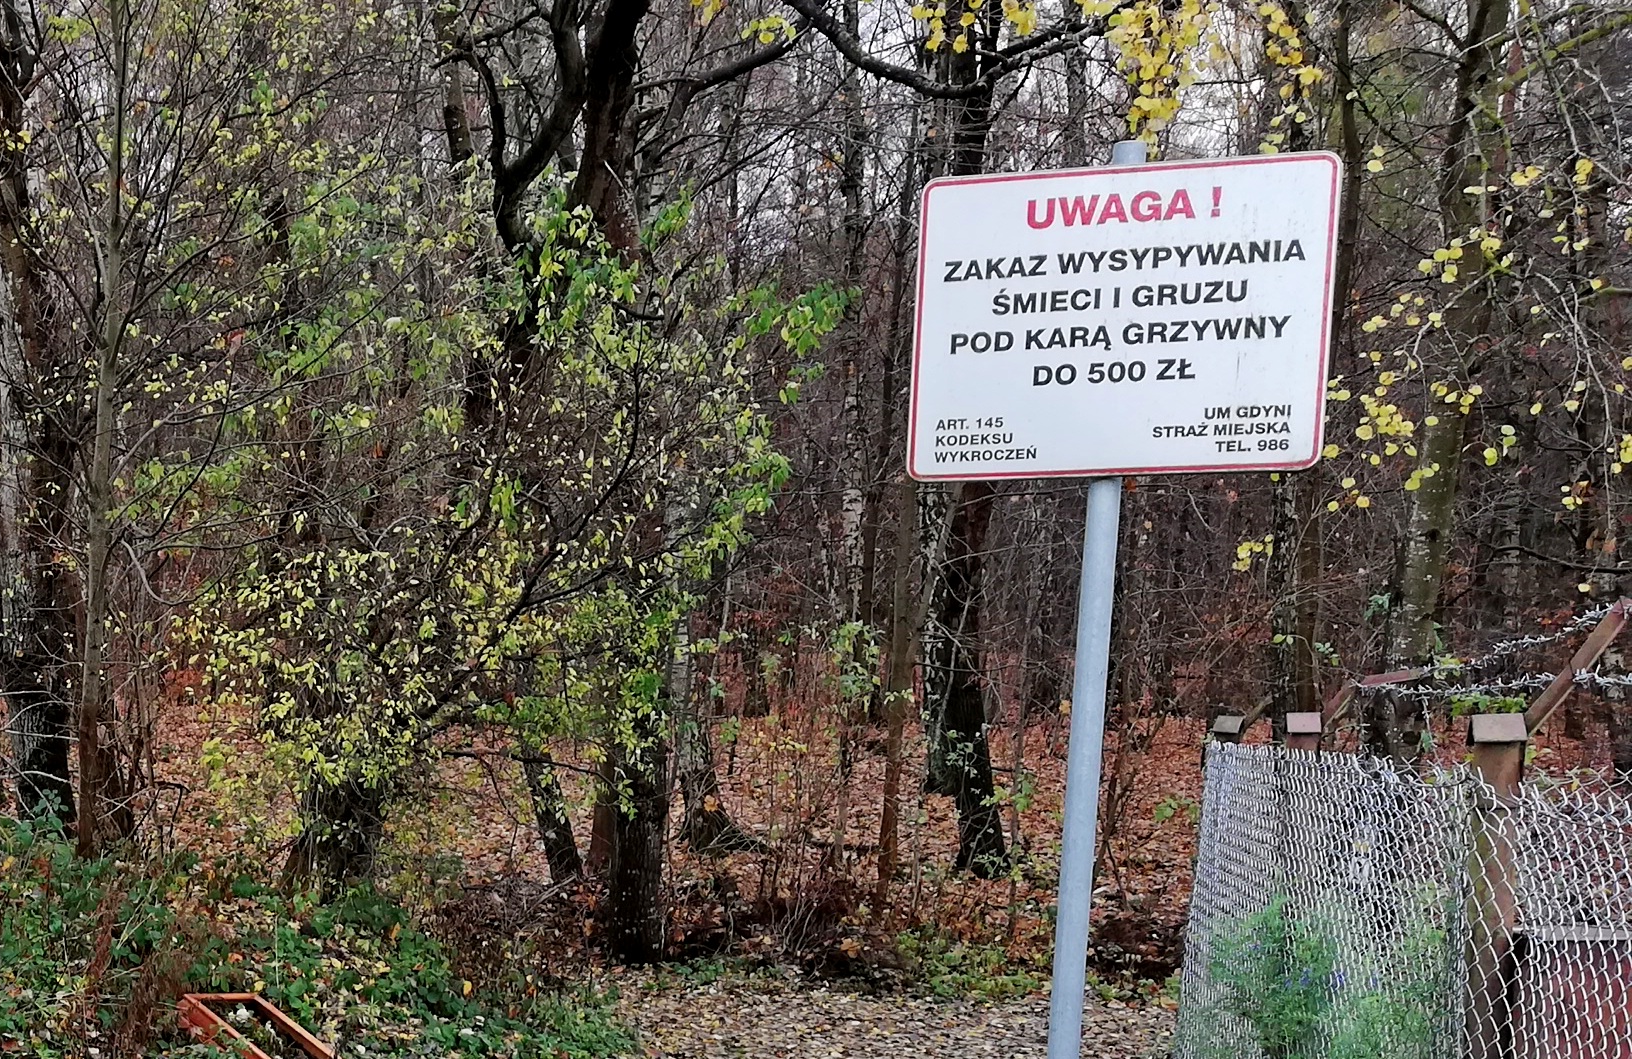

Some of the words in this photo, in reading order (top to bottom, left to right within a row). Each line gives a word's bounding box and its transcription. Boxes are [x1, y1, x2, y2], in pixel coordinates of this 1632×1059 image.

[1027, 188, 1195, 229] UWAGA
[1211, 187, 1222, 217] !
[943, 255, 1047, 282] ZAKAZ
[1058, 239, 1306, 276] WYSYPYWANIA
[991, 289, 1101, 315] ŚMIECI
[1113, 287, 1120, 308] I
[1132, 280, 1248, 307] GRUZU
[950, 332, 1013, 354] POD
[1024, 326, 1112, 351] KARĄ
[1122, 315, 1291, 347] GRZYWNY
[1032, 364, 1076, 386] DO
[1087, 361, 1146, 383] 500
[1156, 359, 1195, 380] ZŁ
[1204, 407, 1230, 420] UM
[1236, 404, 1291, 418] GDYNI
[936, 418, 969, 431] ART.
[975, 417, 1004, 428] 145
[1152, 423, 1208, 438] STRAŻ
[1213, 422, 1291, 436] MIEJSKA
[935, 432, 1013, 446] KODEKSU
[1215, 440, 1251, 453] TEL.
[1258, 439, 1290, 451] 986
[934, 445, 1037, 463] WYKROCZEŃ
